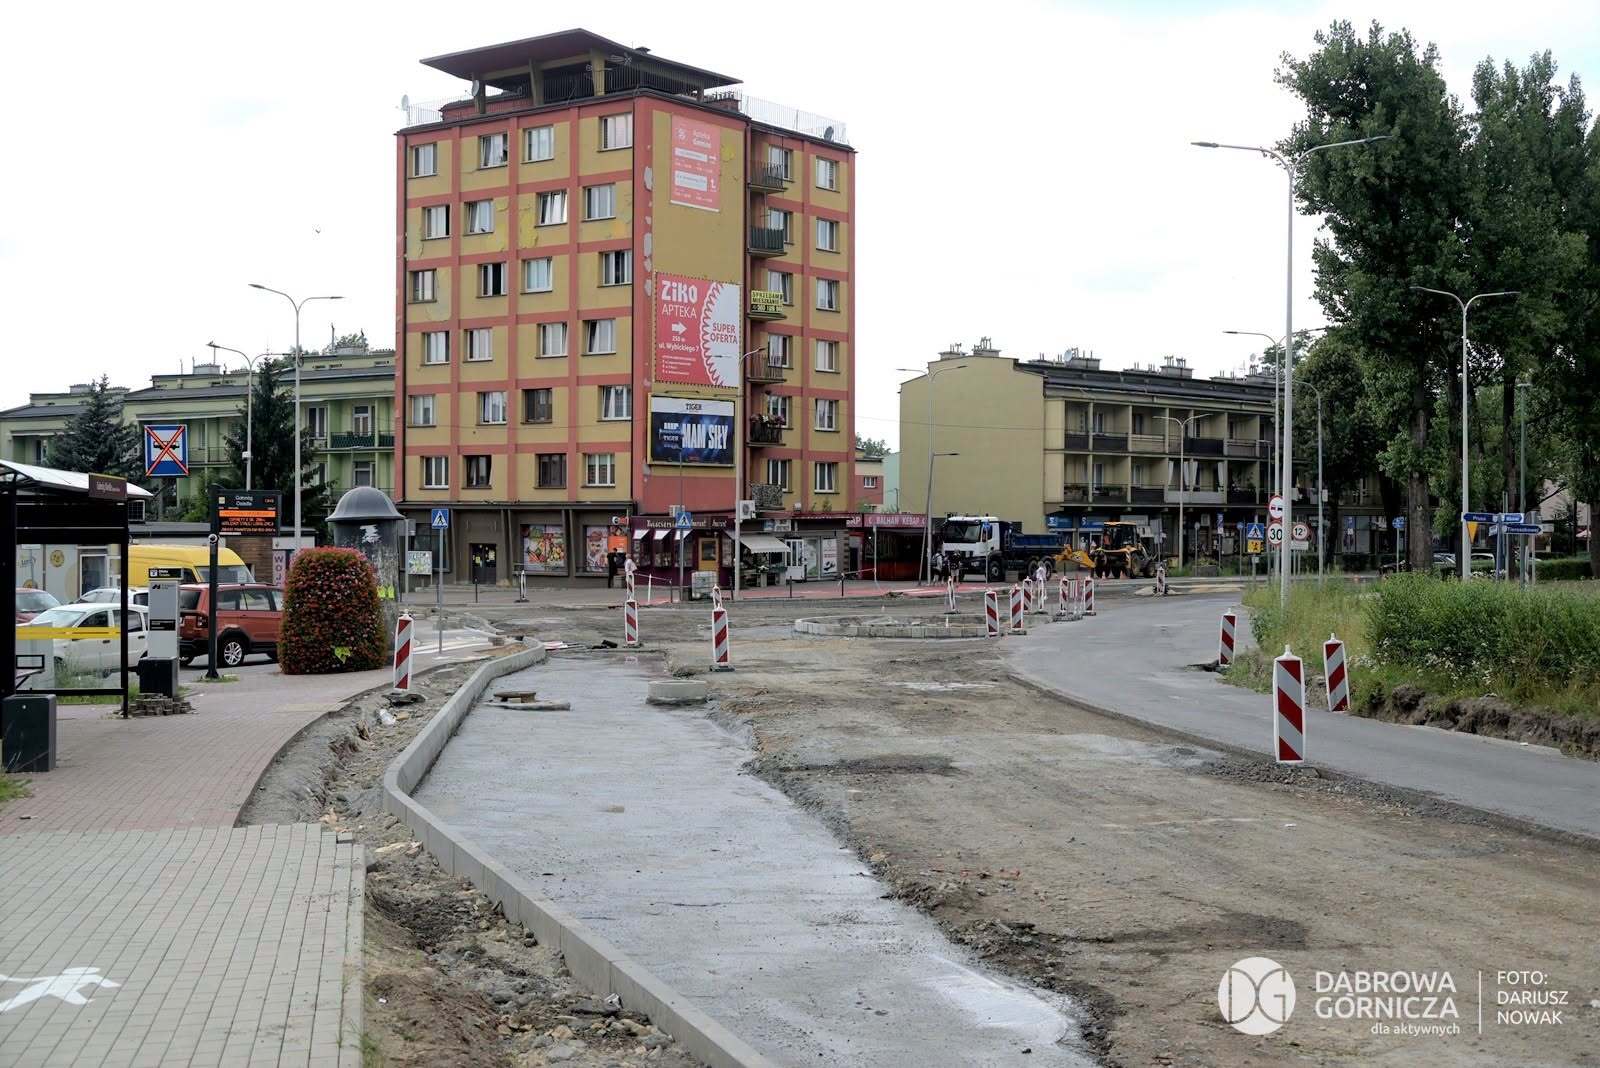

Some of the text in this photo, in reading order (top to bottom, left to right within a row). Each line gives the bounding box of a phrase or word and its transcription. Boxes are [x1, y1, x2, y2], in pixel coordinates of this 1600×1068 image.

[661, 303, 697, 319] APTEKA
[712, 322, 736, 334] SUPER
[710, 333, 738, 345] OFERTA
[685, 403, 703, 411] TIGER
[682, 423, 729, 450] MAM SIŁY
[1269, 528, 1283, 541] 30
